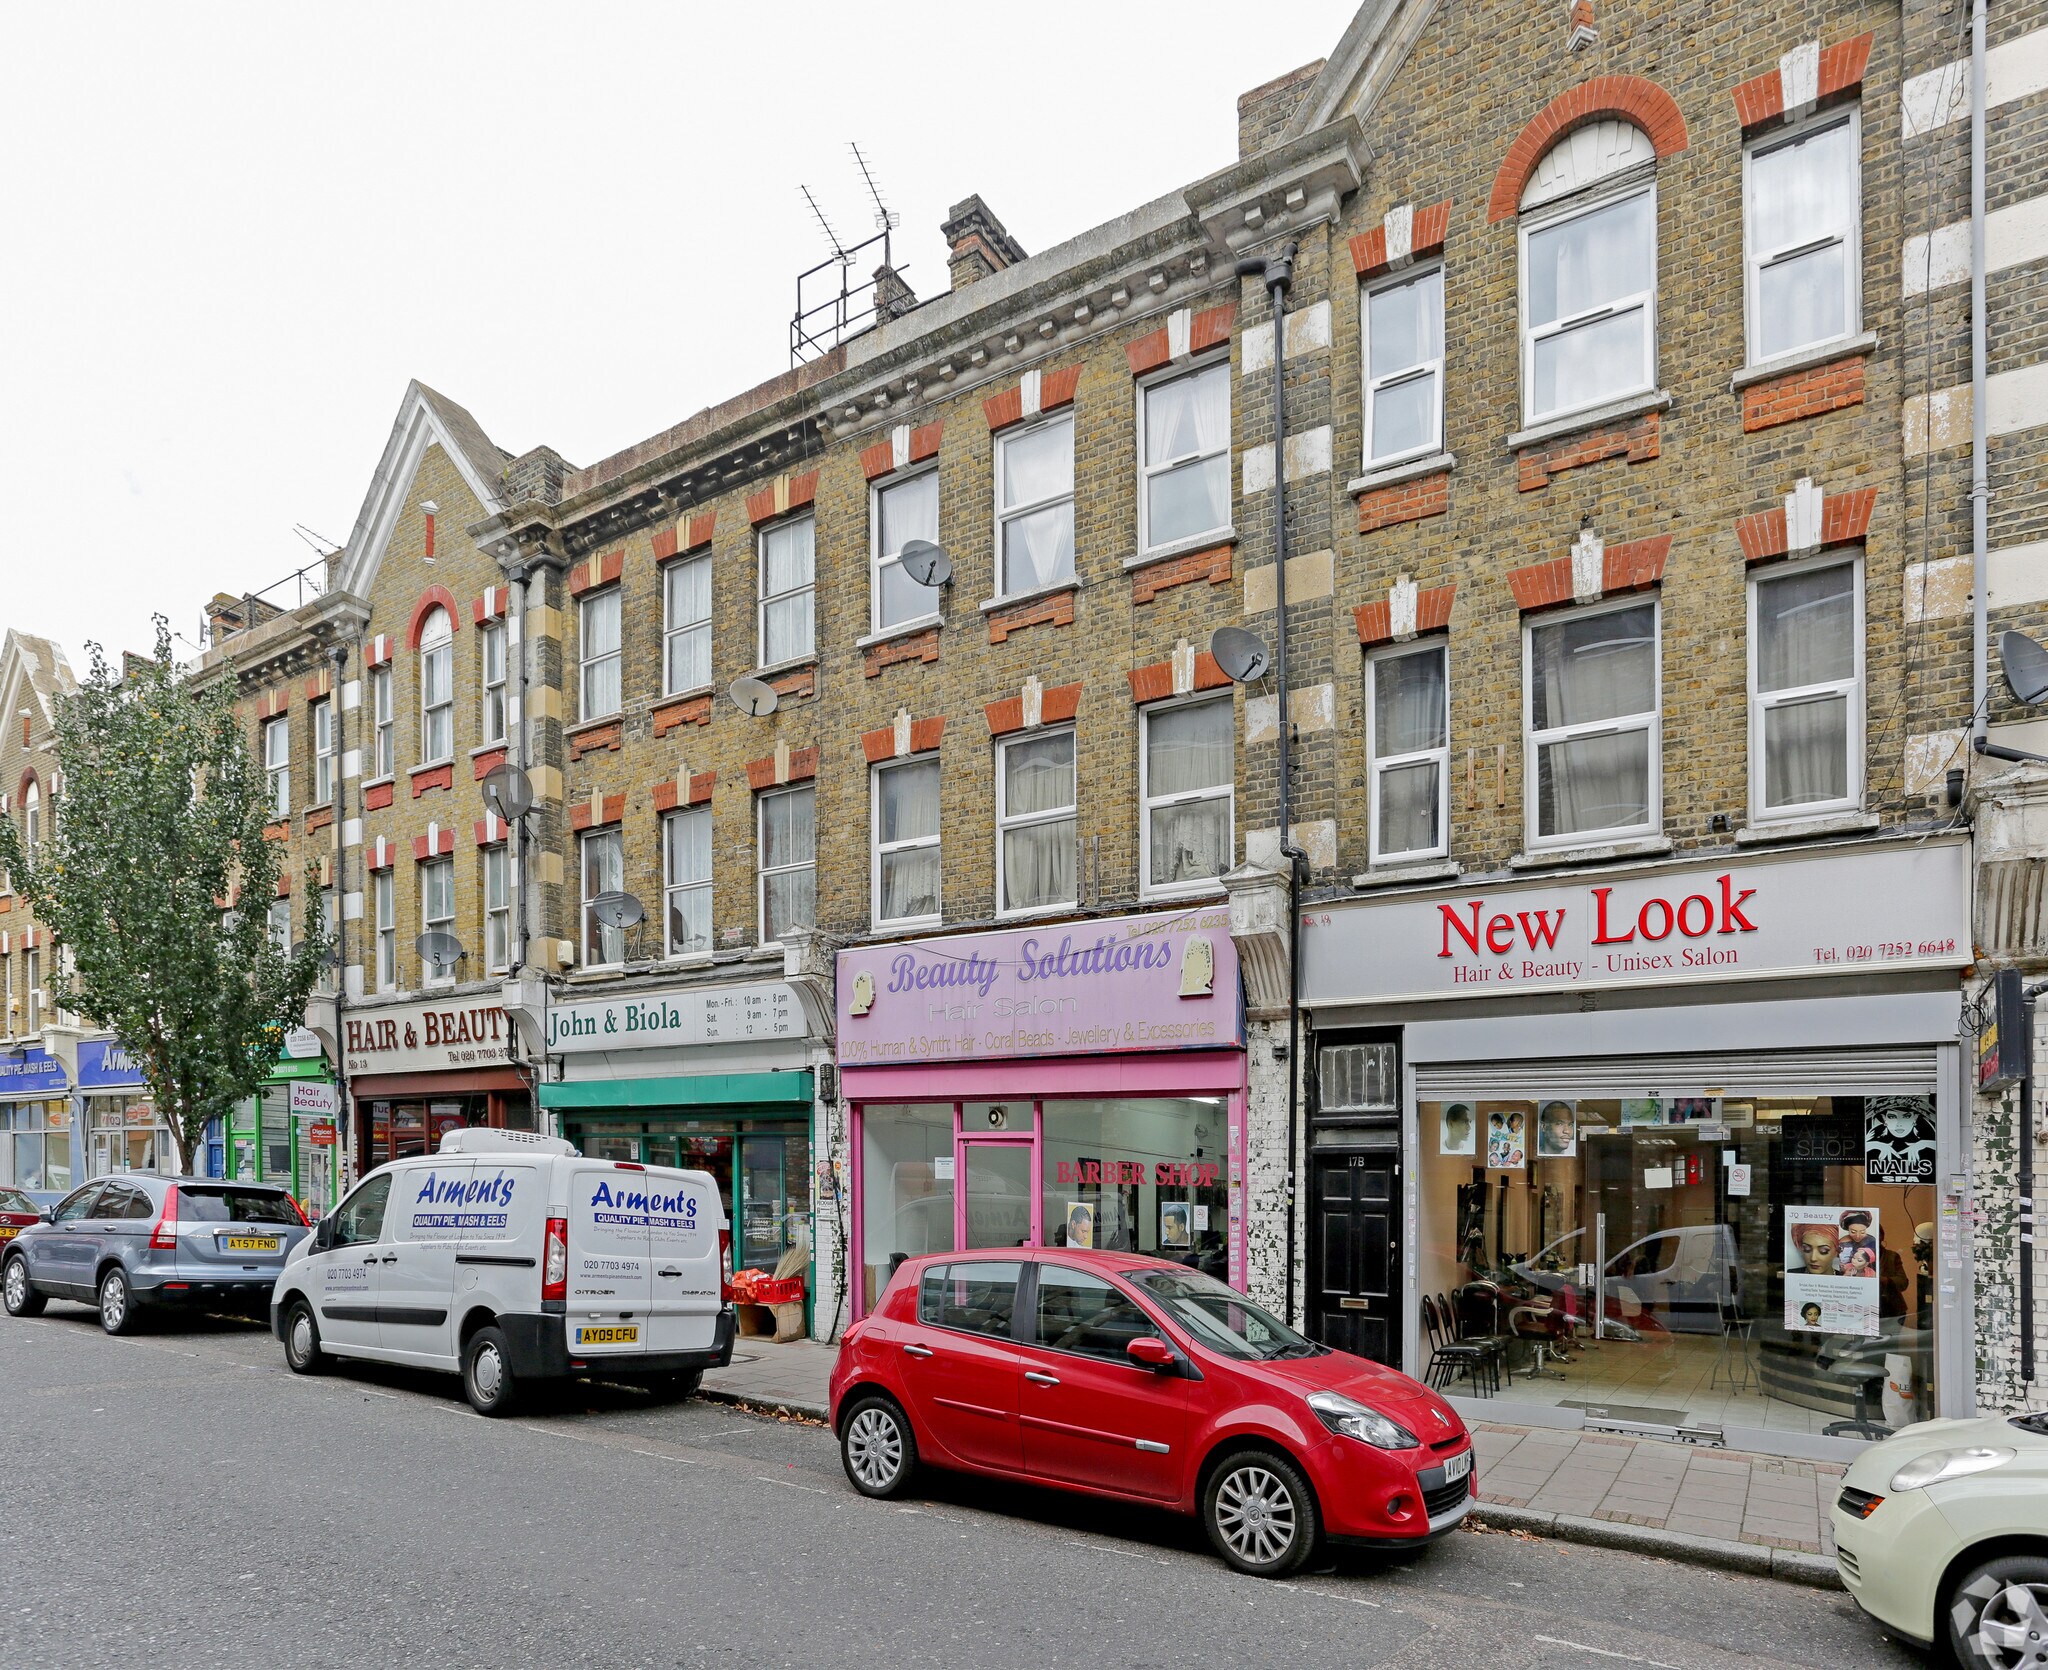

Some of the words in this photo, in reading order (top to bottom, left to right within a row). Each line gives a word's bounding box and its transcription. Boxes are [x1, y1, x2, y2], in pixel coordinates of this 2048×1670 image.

[1437, 900, 1566, 958] New
[1591, 873, 1758, 945] Look
[1143, 920, 1166, 935] 020
[1169, 917, 1197, 933] 7252
[1200, 914, 1230, 929] 6235
[1846, 945, 1873, 959] 020
[1878, 942, 1913, 956] 7252
[1918, 938, 1956, 954] 6648
[887, 952, 1000, 998] Beauty
[1017, 933, 1173, 982] Solutions
[1453, 965, 1492, 983] Hair
[1498, 963, 1514, 980] &
[1521, 960, 1583, 982] Beauty
[1606, 951, 1673, 973] Unisex
[1681, 947, 1739, 968] Salon
[744, 996, 751, 1005] 10
[773, 994, 777, 1003] 8
[778, 995, 788, 1005] pm
[746, 1010, 751, 1019] 9
[773, 1008, 777, 1017] 7
[778, 1010, 788, 1020] pm
[929, 1000, 984, 1023] Hair
[994, 995, 1077, 1019] Salon
[547, 1009, 597, 1047] John
[604, 1008, 619, 1034] &
[625, 1001, 682, 1032] Biola
[745, 1025, 753, 1034] 12
[773, 1024, 778, 1032] 5
[778, 1025, 788, 1034] pm
[345, 1019, 399, 1053] HAIR
[404, 1021, 418, 1049] &
[840, 1040, 868, 1061] 100%
[870, 1039, 907, 1056] Human
[908, 1037, 918, 1054] &
[954, 1033, 976, 1052] Hair
[984, 1030, 1014, 1049] Coral
[1018, 1028, 1055, 1047] Beads
[1065, 1025, 1121, 1046] Jewellery
[1123, 1022, 1135, 1041] &
[1138, 1019, 1216, 1041] Excessories
[448, 1051, 460, 1062] Tel
[461, 1050, 475, 1061] 020
[477, 1048, 496, 1059] 7703
[360, 1059, 368, 1069] 13
[297, 1086, 320, 1097] Hair
[294, 1096, 333, 1110] Beauty
[1796, 1139, 1857, 1157] SHOP
[1349, 1156, 1365, 1167] 17B
[1870, 1159, 1933, 1176] NAILS
[1056, 1161, 1147, 1185] BARBER
[1155, 1162, 1220, 1187] SHOP
[1882, 1175, 1920, 1183] SPA
[416, 1169, 515, 1208] Arments
[590, 1181, 697, 1218] Arments
[413, 1215, 444, 1227] QUALITY
[457, 1215, 479, 1227] MASH
[480, 1215, 486, 1226] &
[487, 1215, 506, 1227] EELS
[597, 1214, 632, 1224] QUALITY
[649, 1218, 669, 1227] MASH
[670, 1219, 675, 1227] &
[676, 1220, 694, 1229] EELS
[1803, 1212, 1834, 1220] Beauty
[230, 1239, 255, 1249] AT57
[583, 1260, 599, 1270] 020
[600, 1260, 620, 1270] 7703
[621, 1261, 640, 1271] 4974
[327, 1268, 338, 1280] 020
[338, 1268, 352, 1279] 7703
[352, 1268, 367, 1279] 4974
[583, 1329, 613, 1342] AY09
[615, 1328, 637, 1341] CFU
